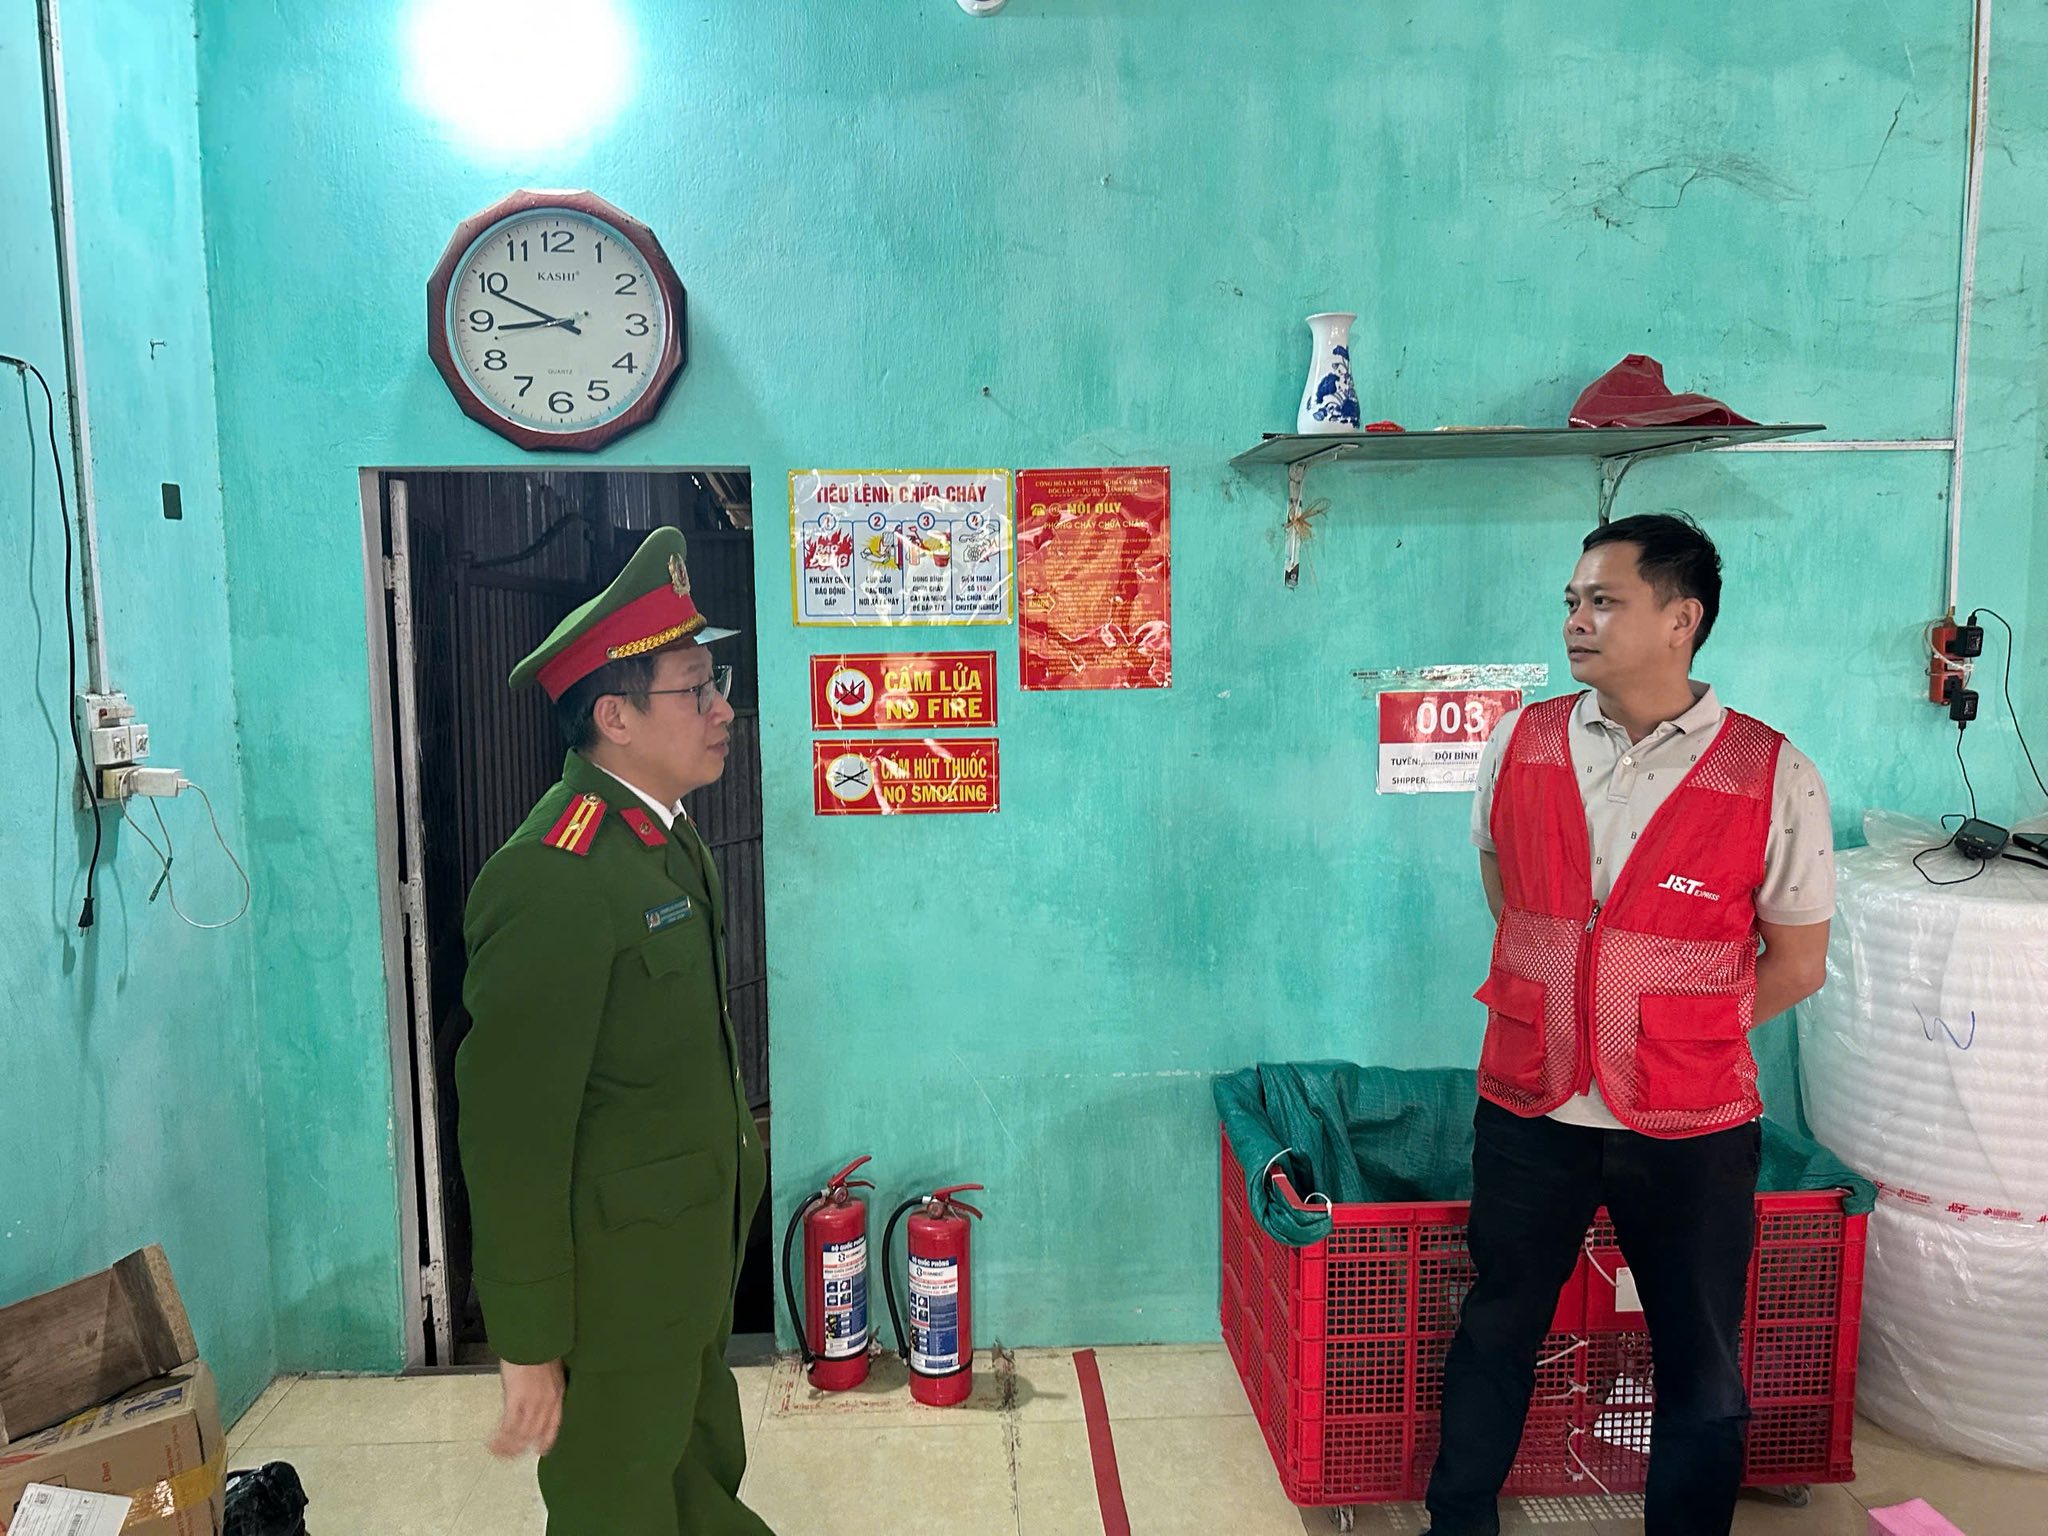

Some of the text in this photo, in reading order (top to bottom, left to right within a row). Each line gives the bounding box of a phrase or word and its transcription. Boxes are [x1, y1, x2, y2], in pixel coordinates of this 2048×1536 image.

[507, 239, 529, 262] 11
[541, 230, 575, 253] 12
[595, 241, 602, 263] 1
[479, 272, 508, 293] 10
[537, 271, 575, 281] KASHI
[615, 273, 637, 296] 2
[469, 309, 494, 332] 9
[625, 313, 650, 336] 3
[483, 349, 508, 371] 8
[612, 352, 638, 374] 4
[513, 376, 534, 397] 7
[586, 380, 610, 401] 5
[548, 391, 575, 414] 6
[946, 482, 987, 503] CHÁY
[1095, 502, 1122, 514] QUY
[873, 516, 881, 527] 2
[922, 515, 930, 526] 3
[884, 662, 982, 692] CẤM LỬA
[886, 698, 983, 720] NO FIRE
[1416, 701, 1485, 734] 003
[914, 752, 940, 778] HÚT
[944, 749, 988, 779] THUỐC
[1434, 750, 1452, 761] ĐỘI
[1454, 750, 1478, 760] BÌNH
[883, 784, 987, 803] NO SMOKING
[1657, 873, 1705, 895] J&T
